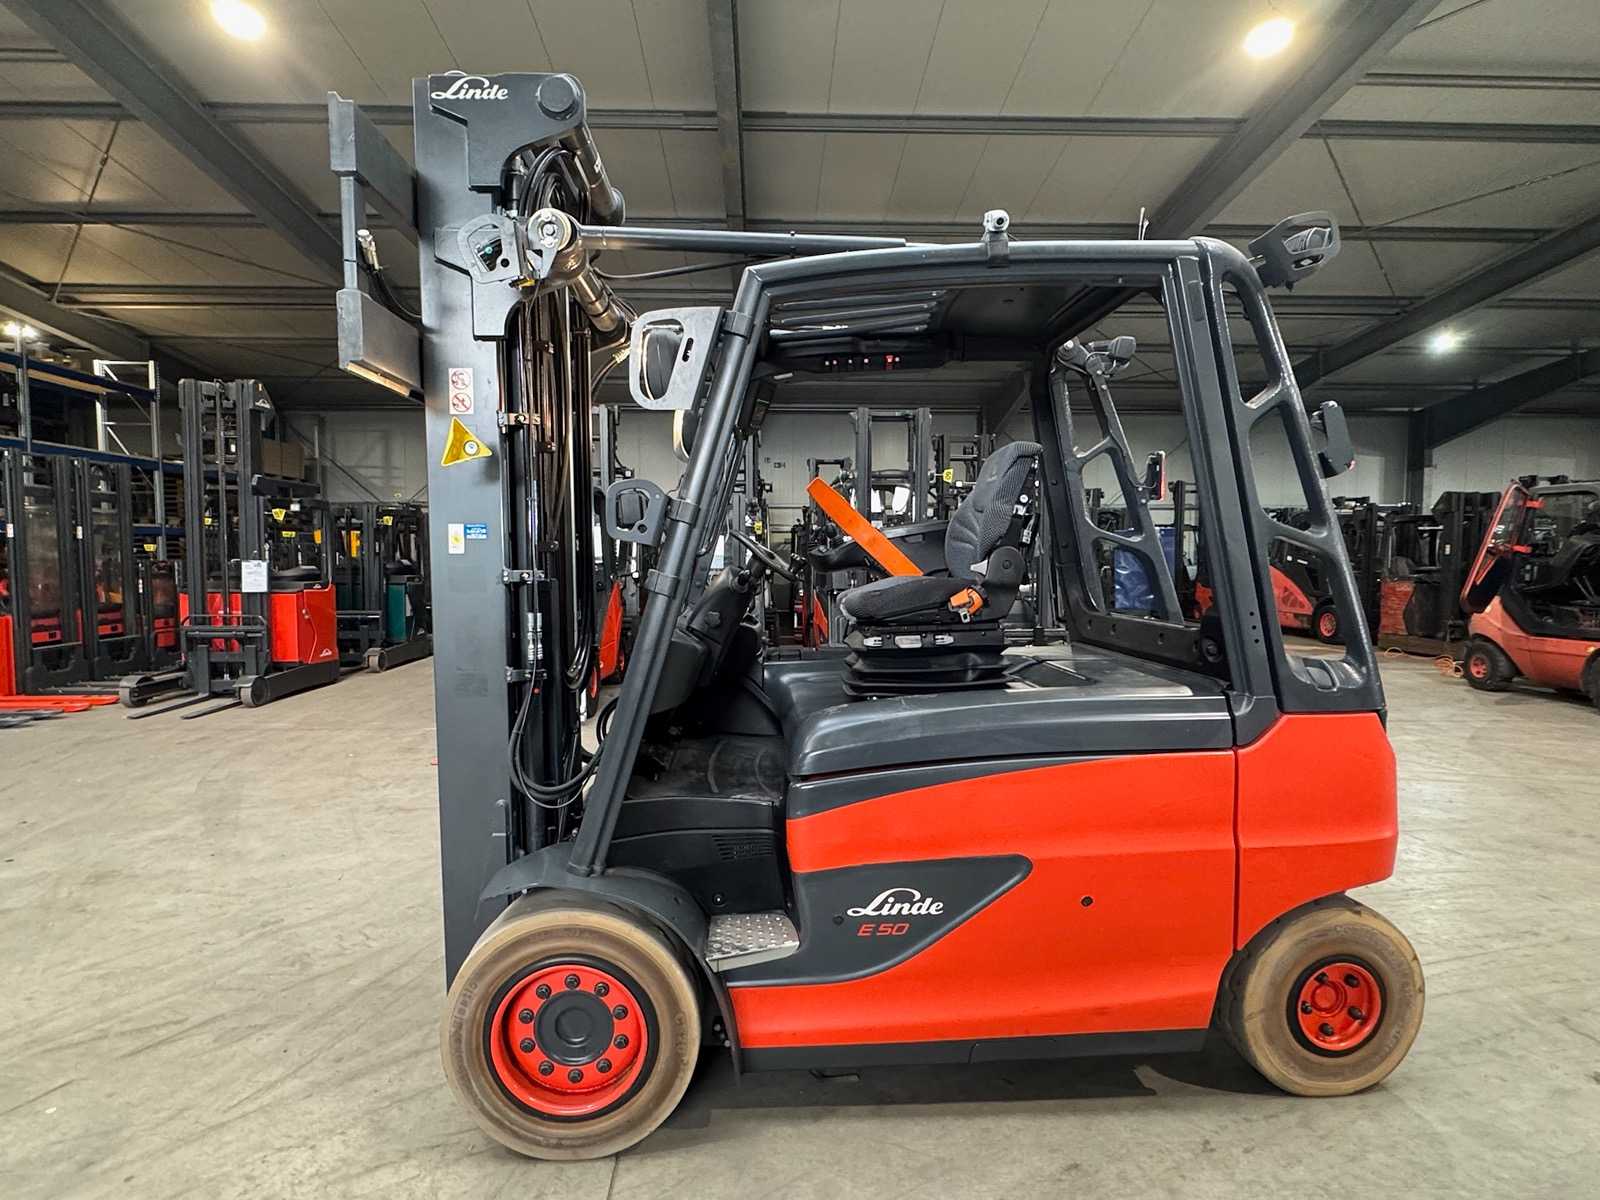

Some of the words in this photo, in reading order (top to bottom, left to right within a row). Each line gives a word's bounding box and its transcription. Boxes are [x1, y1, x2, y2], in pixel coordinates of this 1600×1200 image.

[430, 76, 509, 100] Linde
[846, 887, 944, 917] Linde
[857, 923, 876, 937] E
[876, 922, 911, 936] 50
